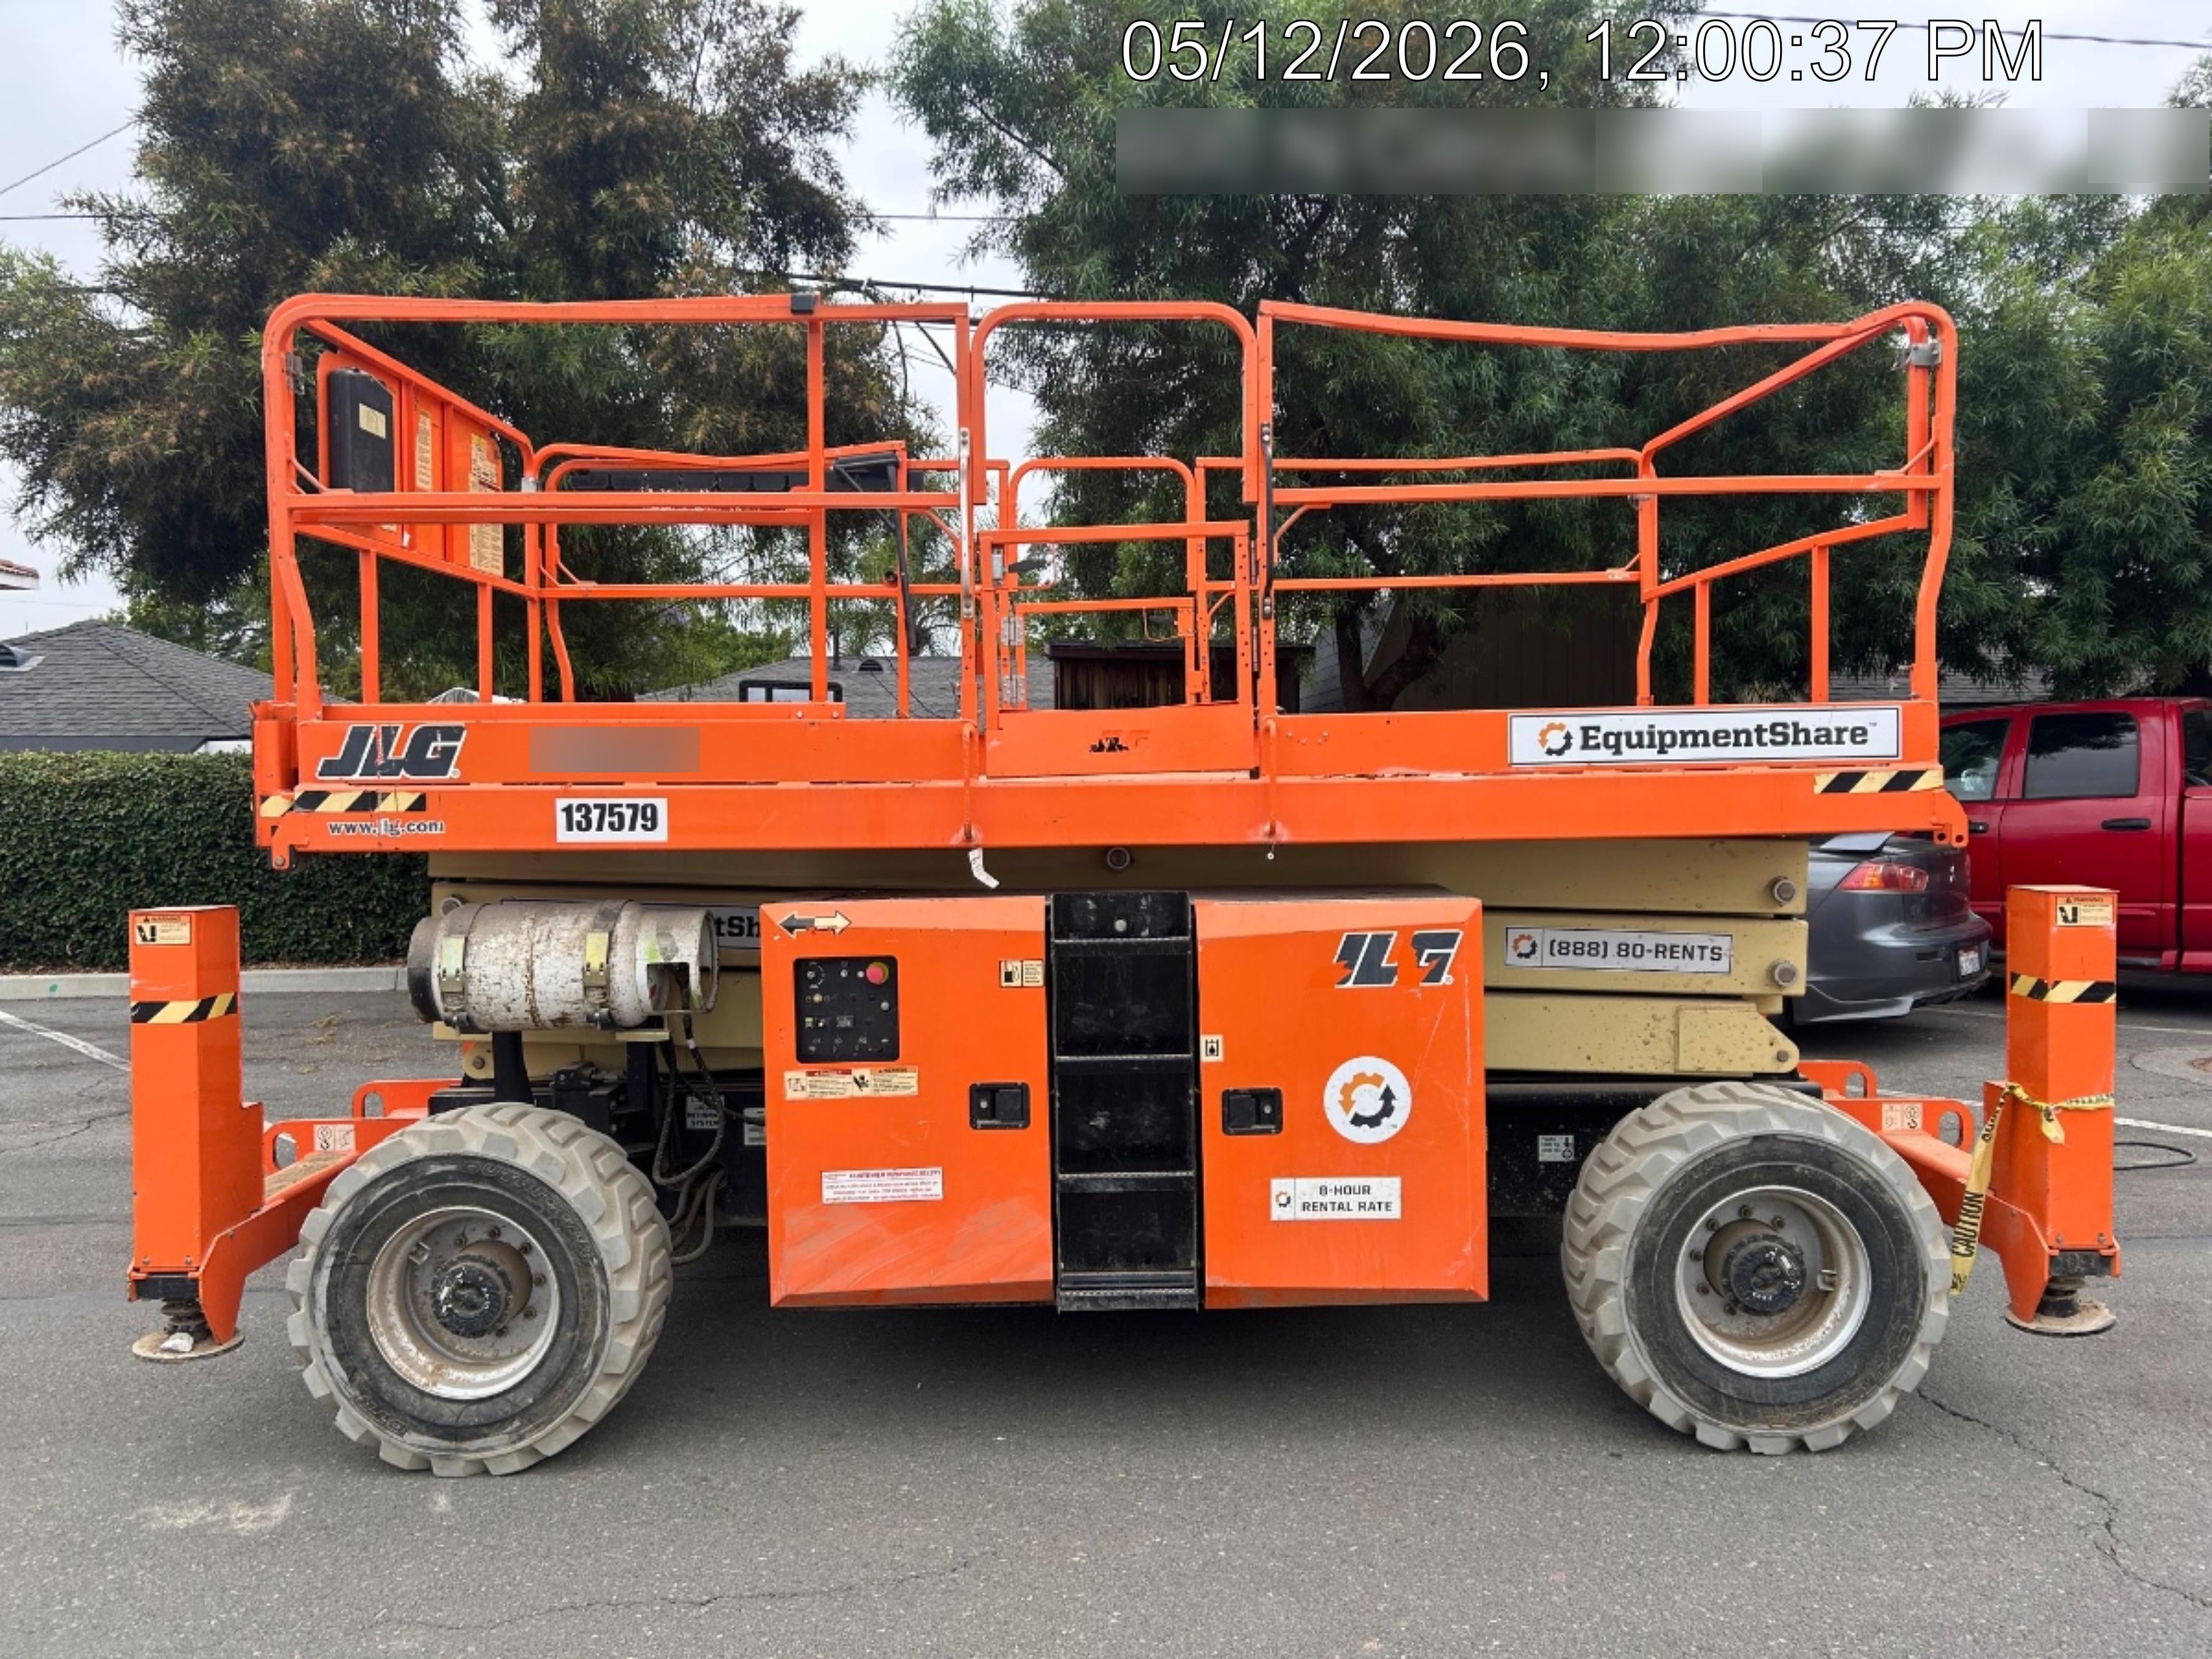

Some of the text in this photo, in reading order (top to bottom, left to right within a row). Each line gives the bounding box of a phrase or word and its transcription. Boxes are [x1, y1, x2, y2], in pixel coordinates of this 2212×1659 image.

[316, 724, 467, 780] JLG
[1579, 721, 1869, 756] EquipmentShare
[561, 802, 659, 833] 137579
[1549, 939, 1723, 962] (888) 80-RENTS
[1319, 1185, 1371, 1196] 8-HOUR
[1302, 1201, 1392, 1212] RENTAL RATE
[1951, 1190, 1983, 1258] CAUTION
